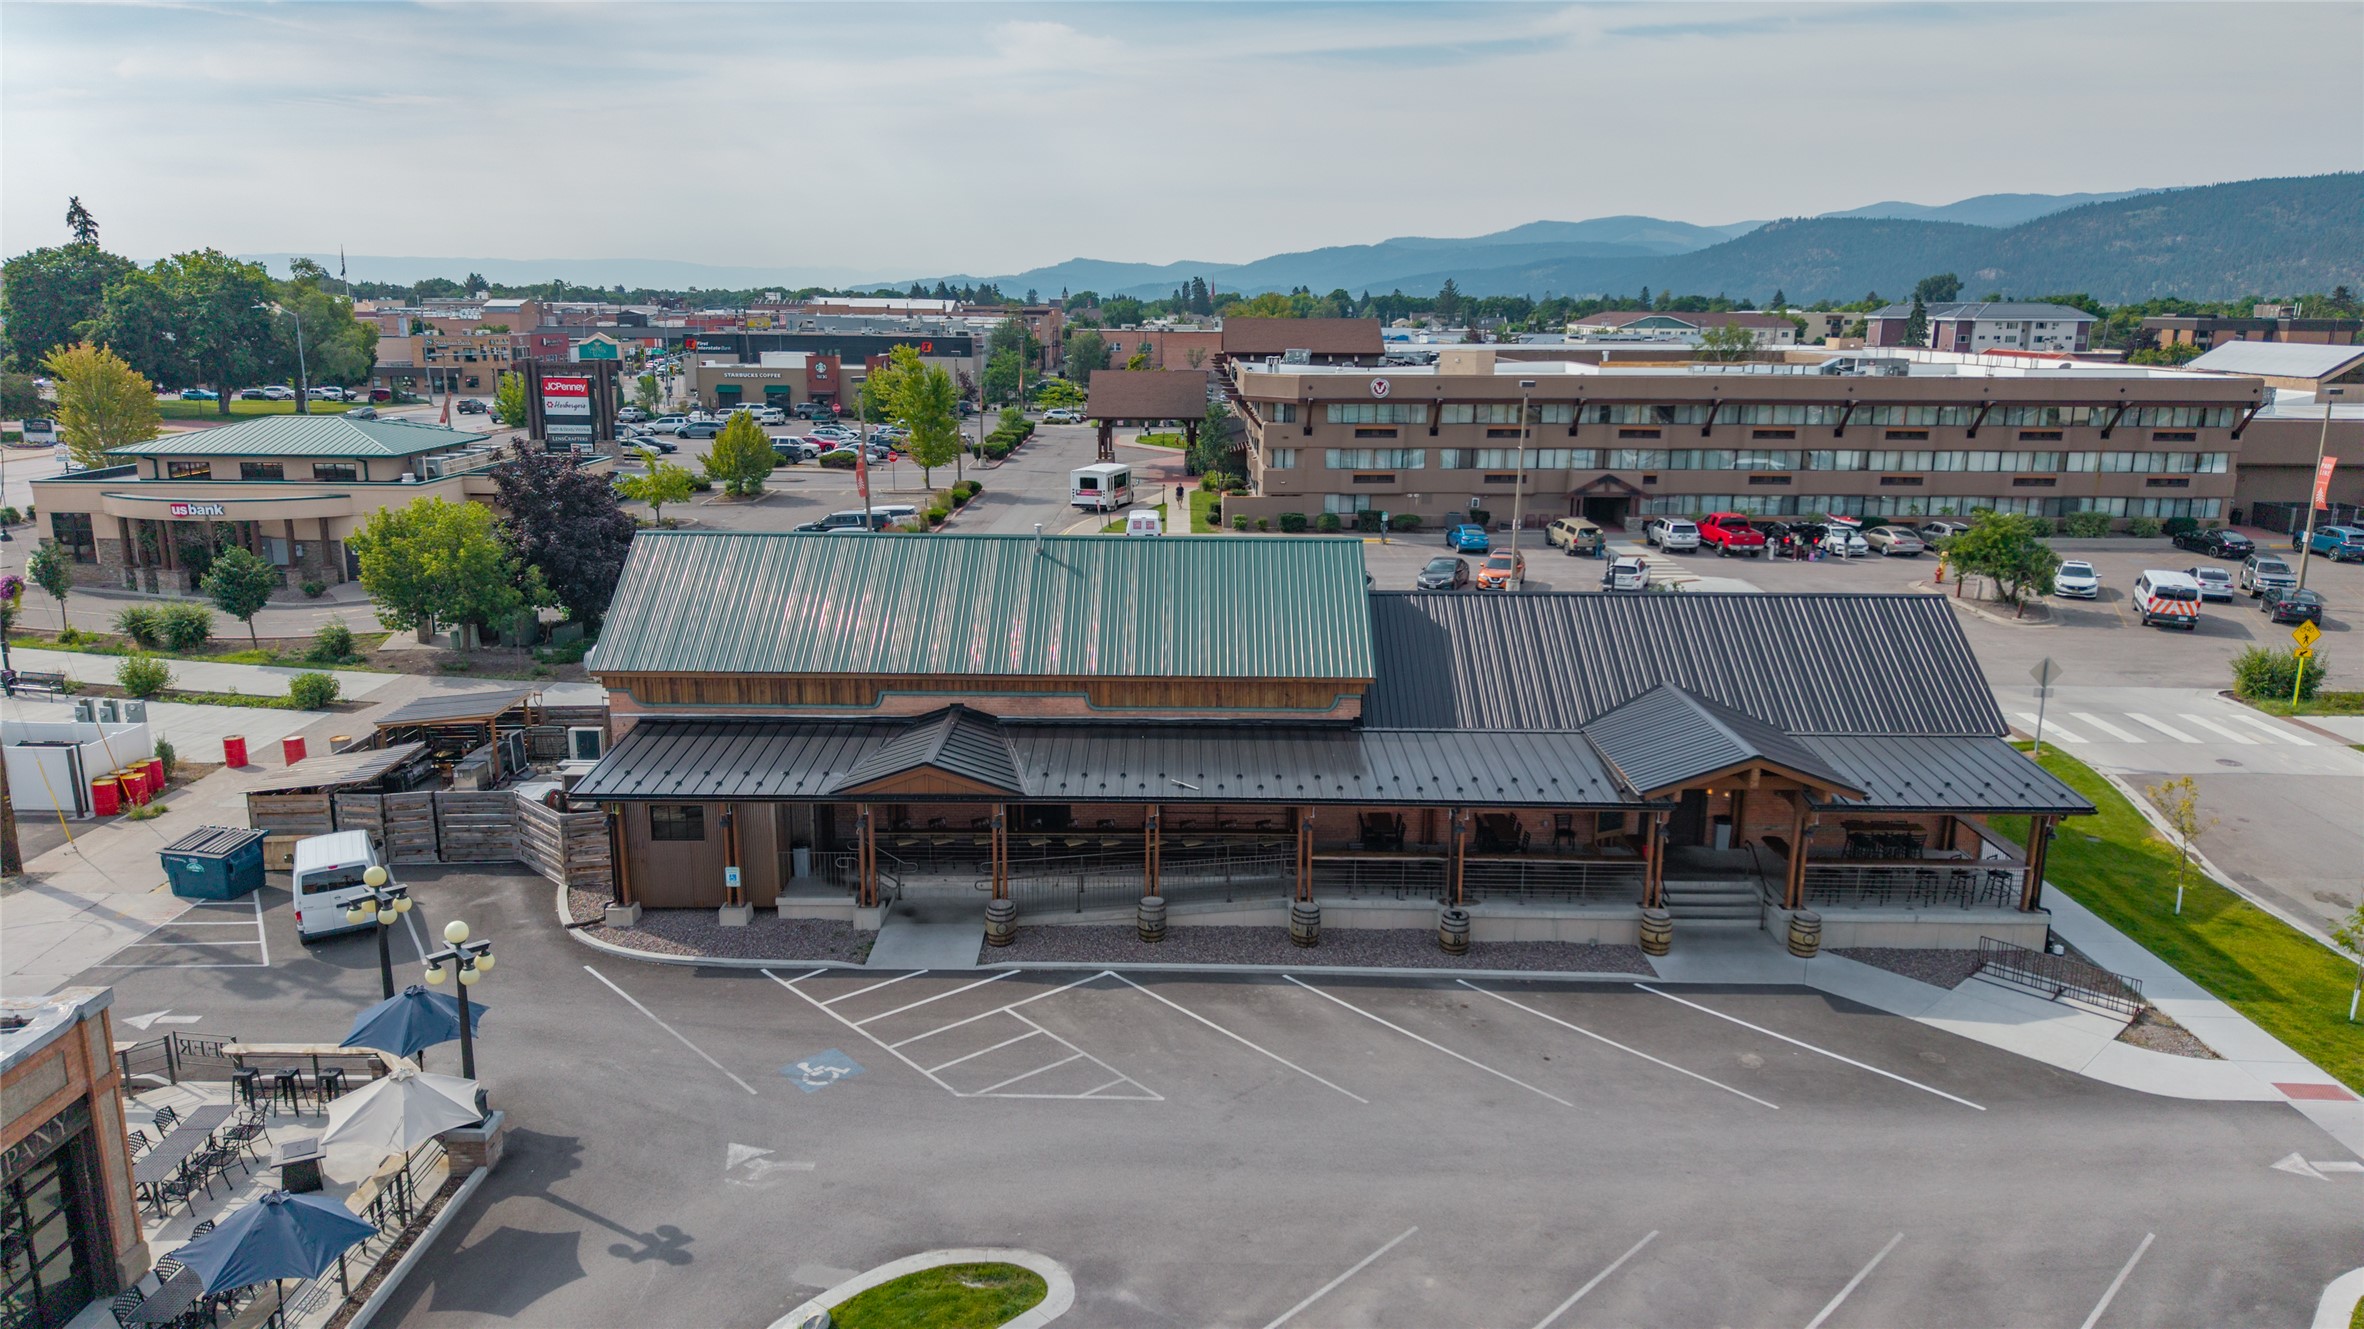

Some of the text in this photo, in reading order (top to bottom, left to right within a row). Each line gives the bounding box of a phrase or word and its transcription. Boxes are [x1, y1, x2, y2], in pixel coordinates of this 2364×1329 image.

[545, 382, 586, 392] JCPenney
[1305, 926, 1314, 937] R
[1452, 934, 1461, 945] B
